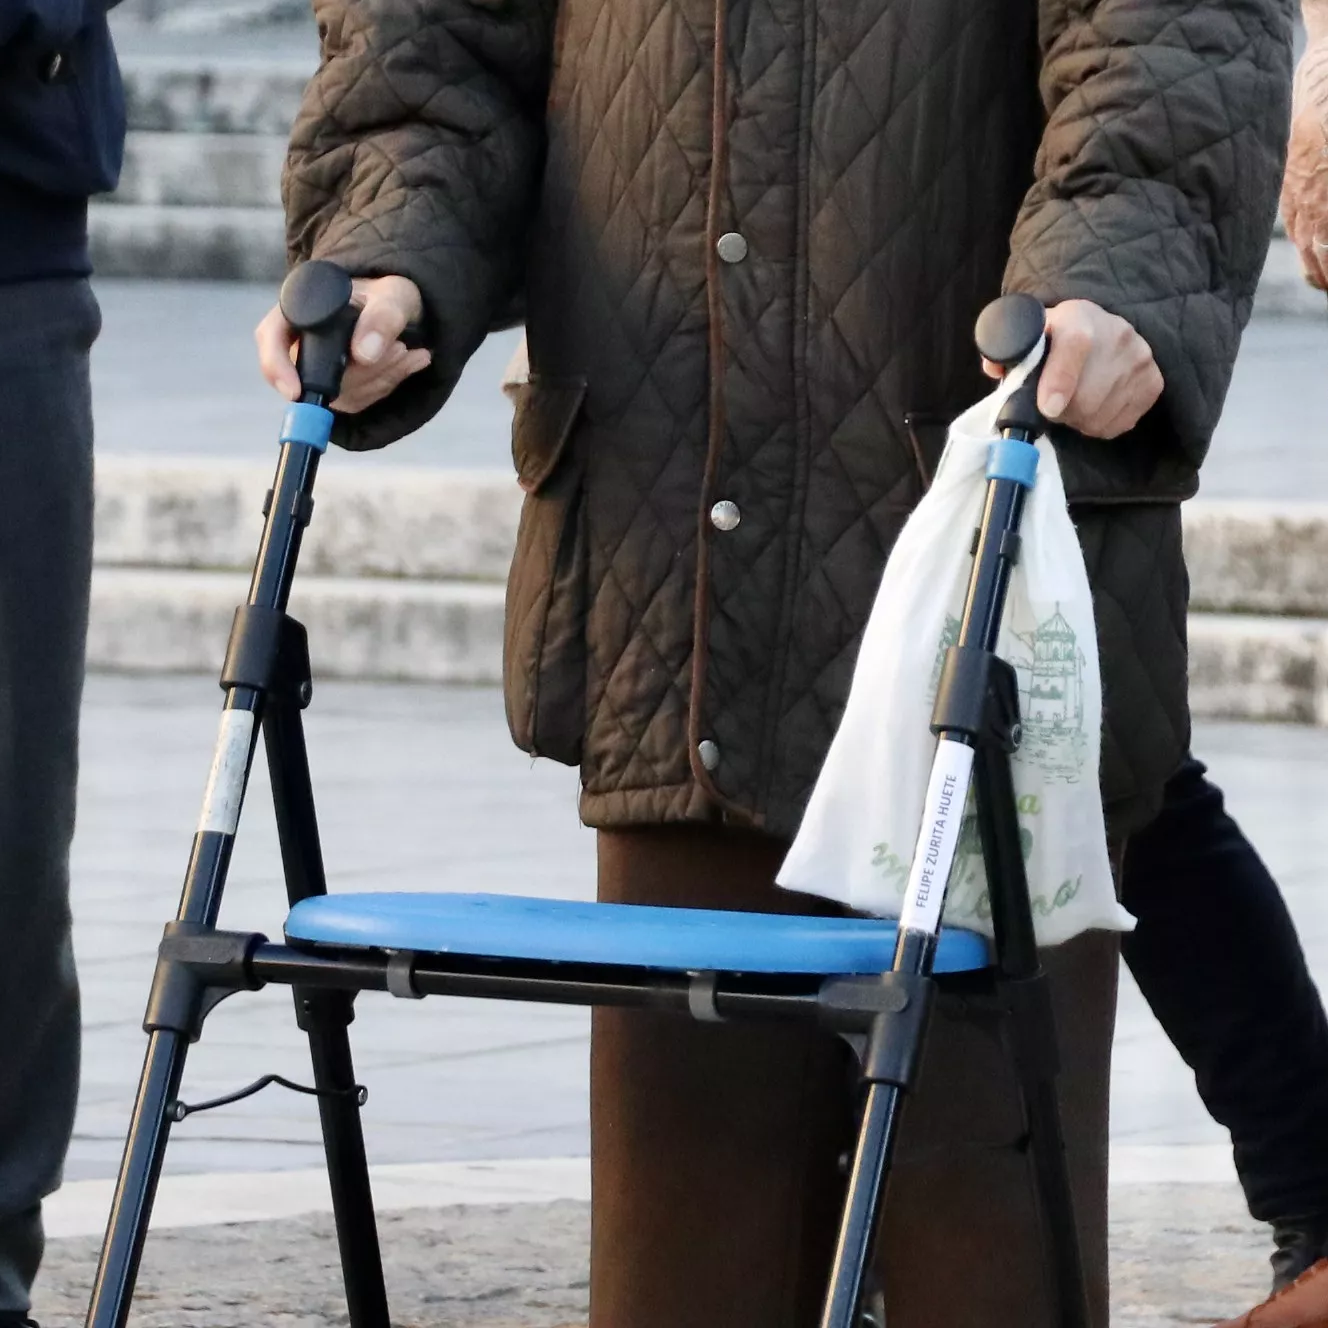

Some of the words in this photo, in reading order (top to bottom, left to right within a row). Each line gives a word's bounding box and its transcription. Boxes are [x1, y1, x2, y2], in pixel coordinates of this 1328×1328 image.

[916, 868, 935, 908] FELIPE
[926, 819, 946, 866] ZURITA
[937, 774, 957, 817] HUETE
